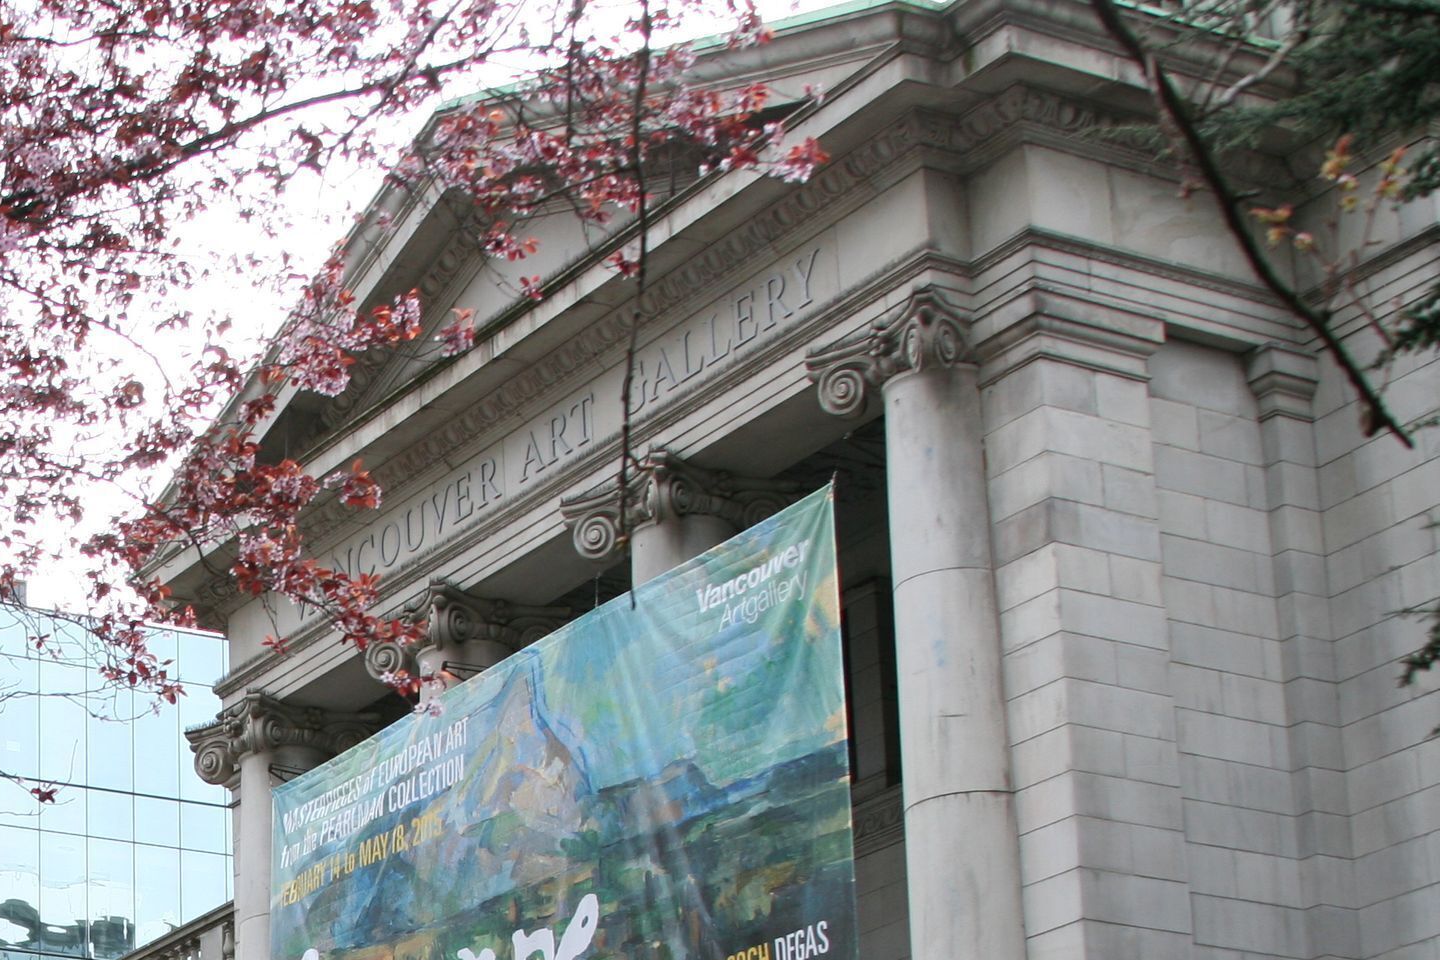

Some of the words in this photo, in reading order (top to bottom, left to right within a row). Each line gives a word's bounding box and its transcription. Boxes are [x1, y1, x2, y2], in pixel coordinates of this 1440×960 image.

[520, 392, 596, 483] ART
[696, 539, 810, 614] Vancouver
[718, 570, 808, 633] Artgallery
[280, 841, 301, 870] from
[302, 827, 317, 857] the
[319, 792, 386, 847] PEARLMAN
[388, 754, 465, 813] COLLECTION
[283, 776, 362, 836] MASTERPIECES
[362, 766, 376, 793] of
[377, 732, 443, 788] EUROPEAN
[445, 716, 469, 754] ART
[330, 853, 341, 881] 14
[344, 852, 356, 875] to
[359, 831, 389, 867] MAY
[412, 806, 446, 847] 2015
